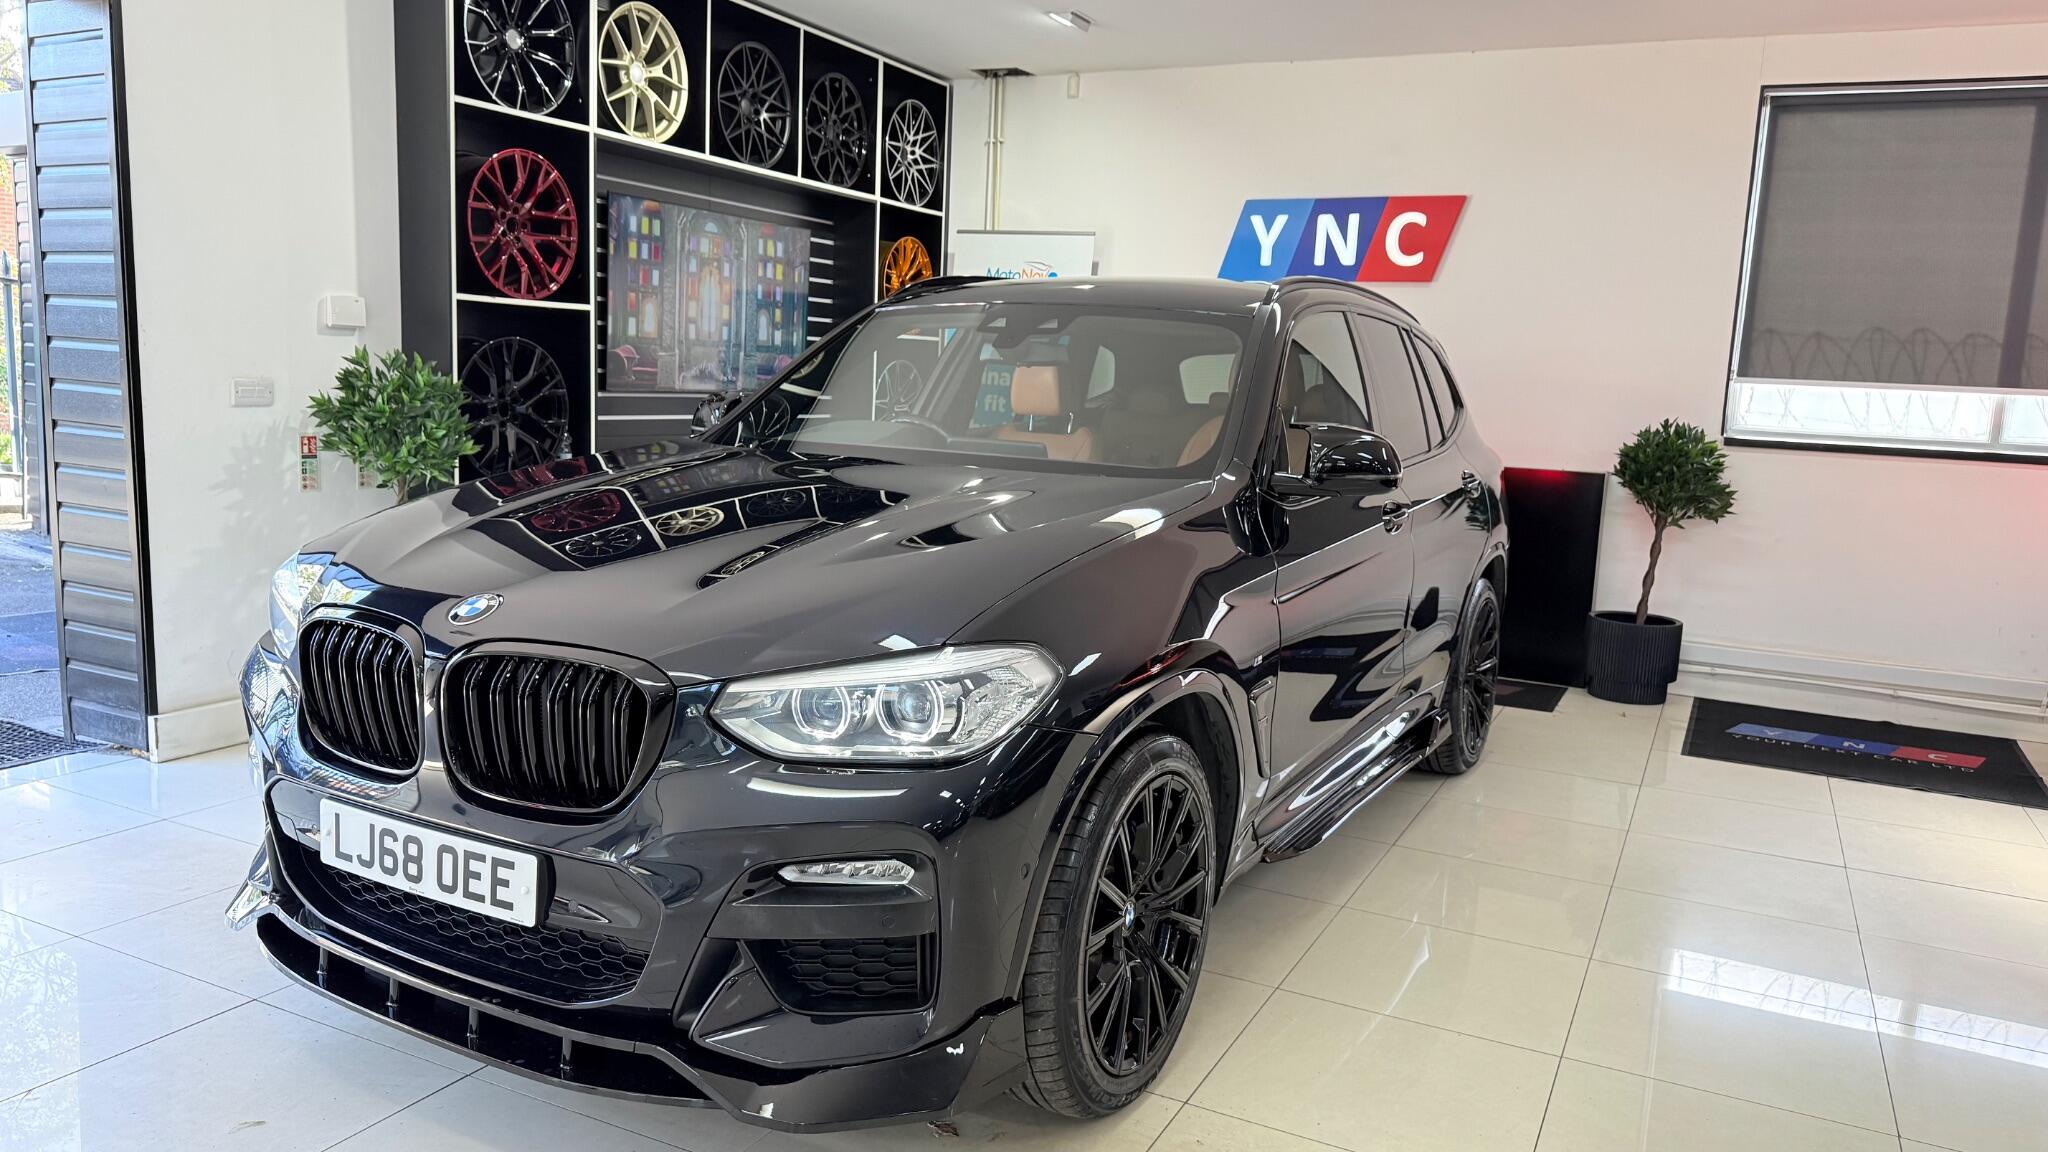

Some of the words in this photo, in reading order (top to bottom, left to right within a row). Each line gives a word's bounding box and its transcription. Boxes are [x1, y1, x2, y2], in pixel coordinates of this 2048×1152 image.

[1250, 211, 1427, 267] YNC
[449, 593, 499, 621] MW
[1732, 734, 1790, 745] YOUR
[1803, 744, 1860, 757] NEXT
[1873, 754, 1918, 765] CAR
[335, 813, 423, 884] LJ68
[436, 844, 515, 912] OEE
